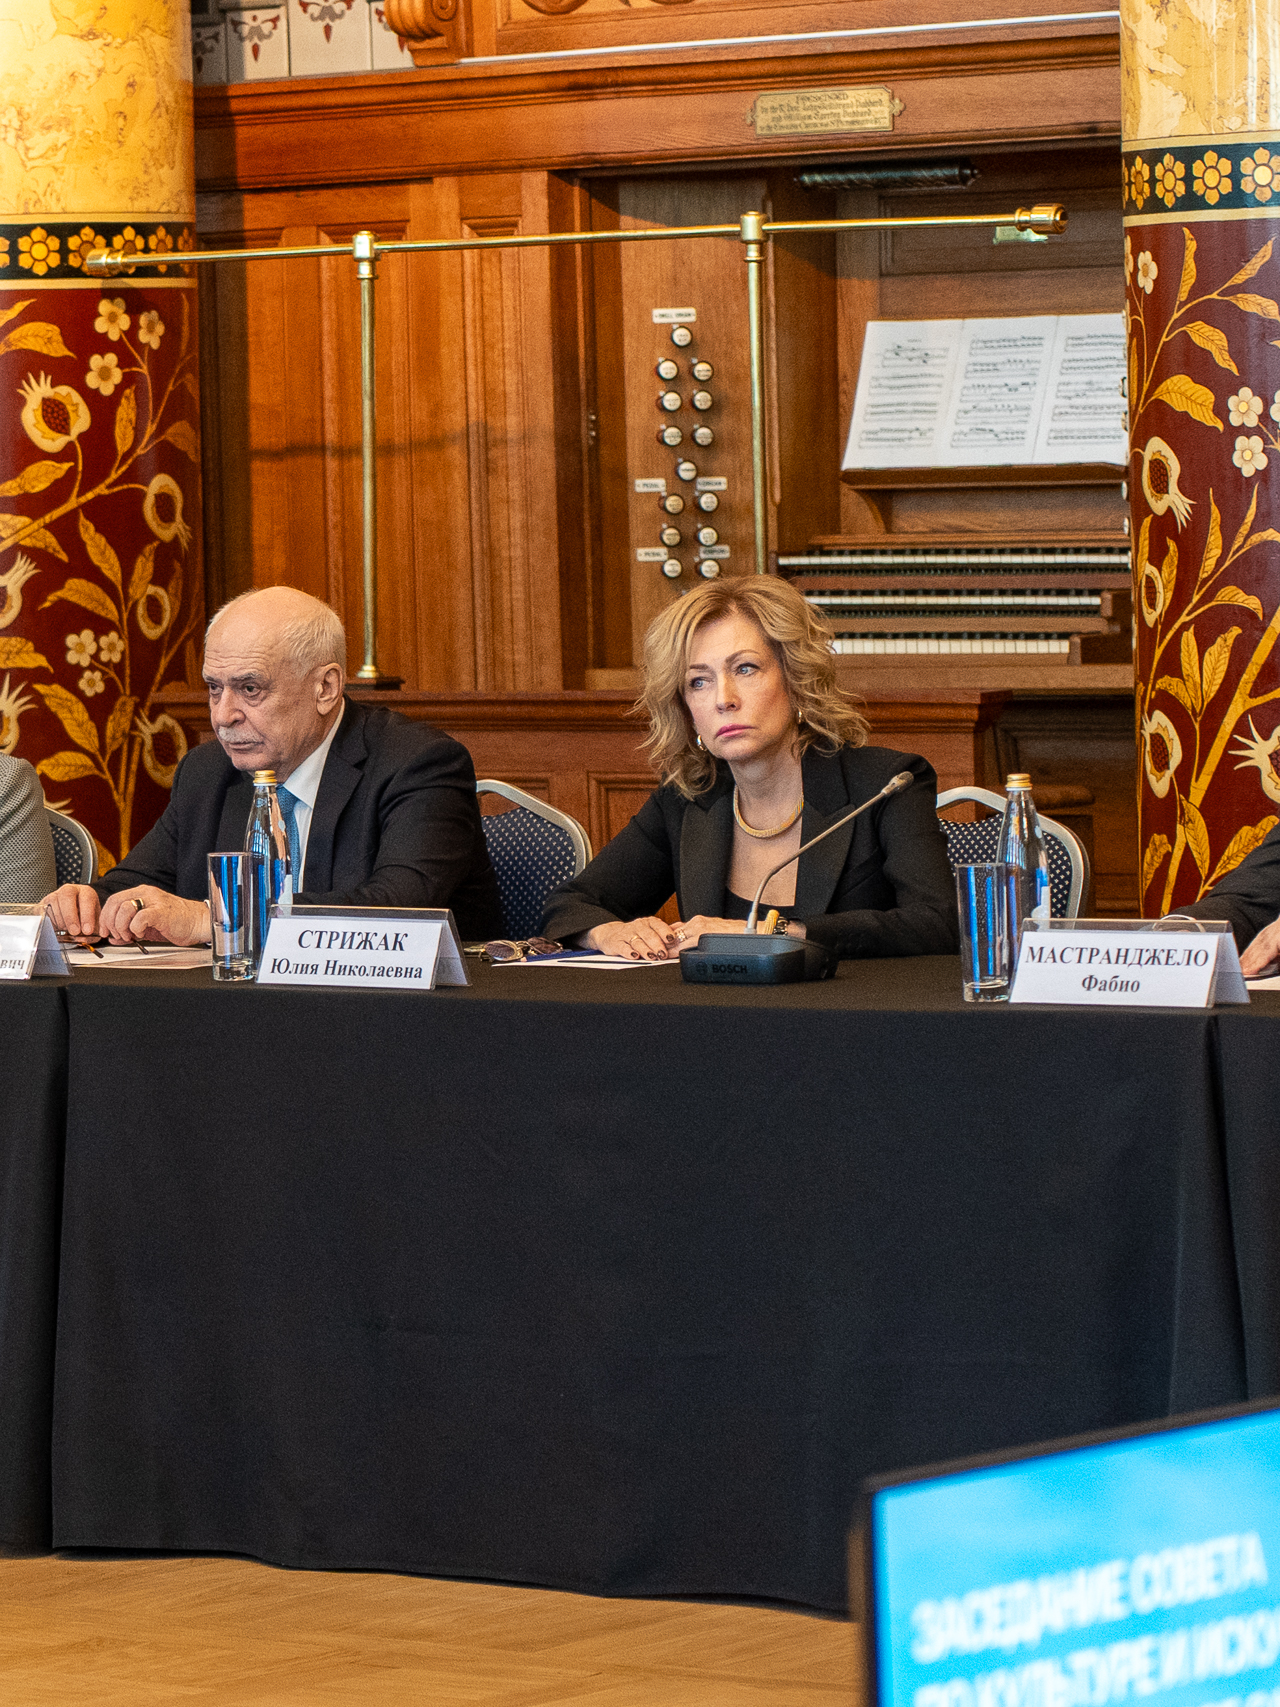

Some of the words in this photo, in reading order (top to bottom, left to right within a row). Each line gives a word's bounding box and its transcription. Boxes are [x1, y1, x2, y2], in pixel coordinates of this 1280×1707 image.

[297, 929, 408, 951] СТРИЖАК
[1025, 945, 1209, 968] МАСТРАНДЖЕЛО
[270, 957, 319, 975] Юлия
[323, 959, 423, 979] Николаевна
[711, 964, 748, 974] BOSCH
[1080, 974, 1141, 993] Фабио
[910, 1559, 1130, 1664] ЗАСЕДАНИЕ
[1130, 1531, 1267, 1614] СОВЕТА
